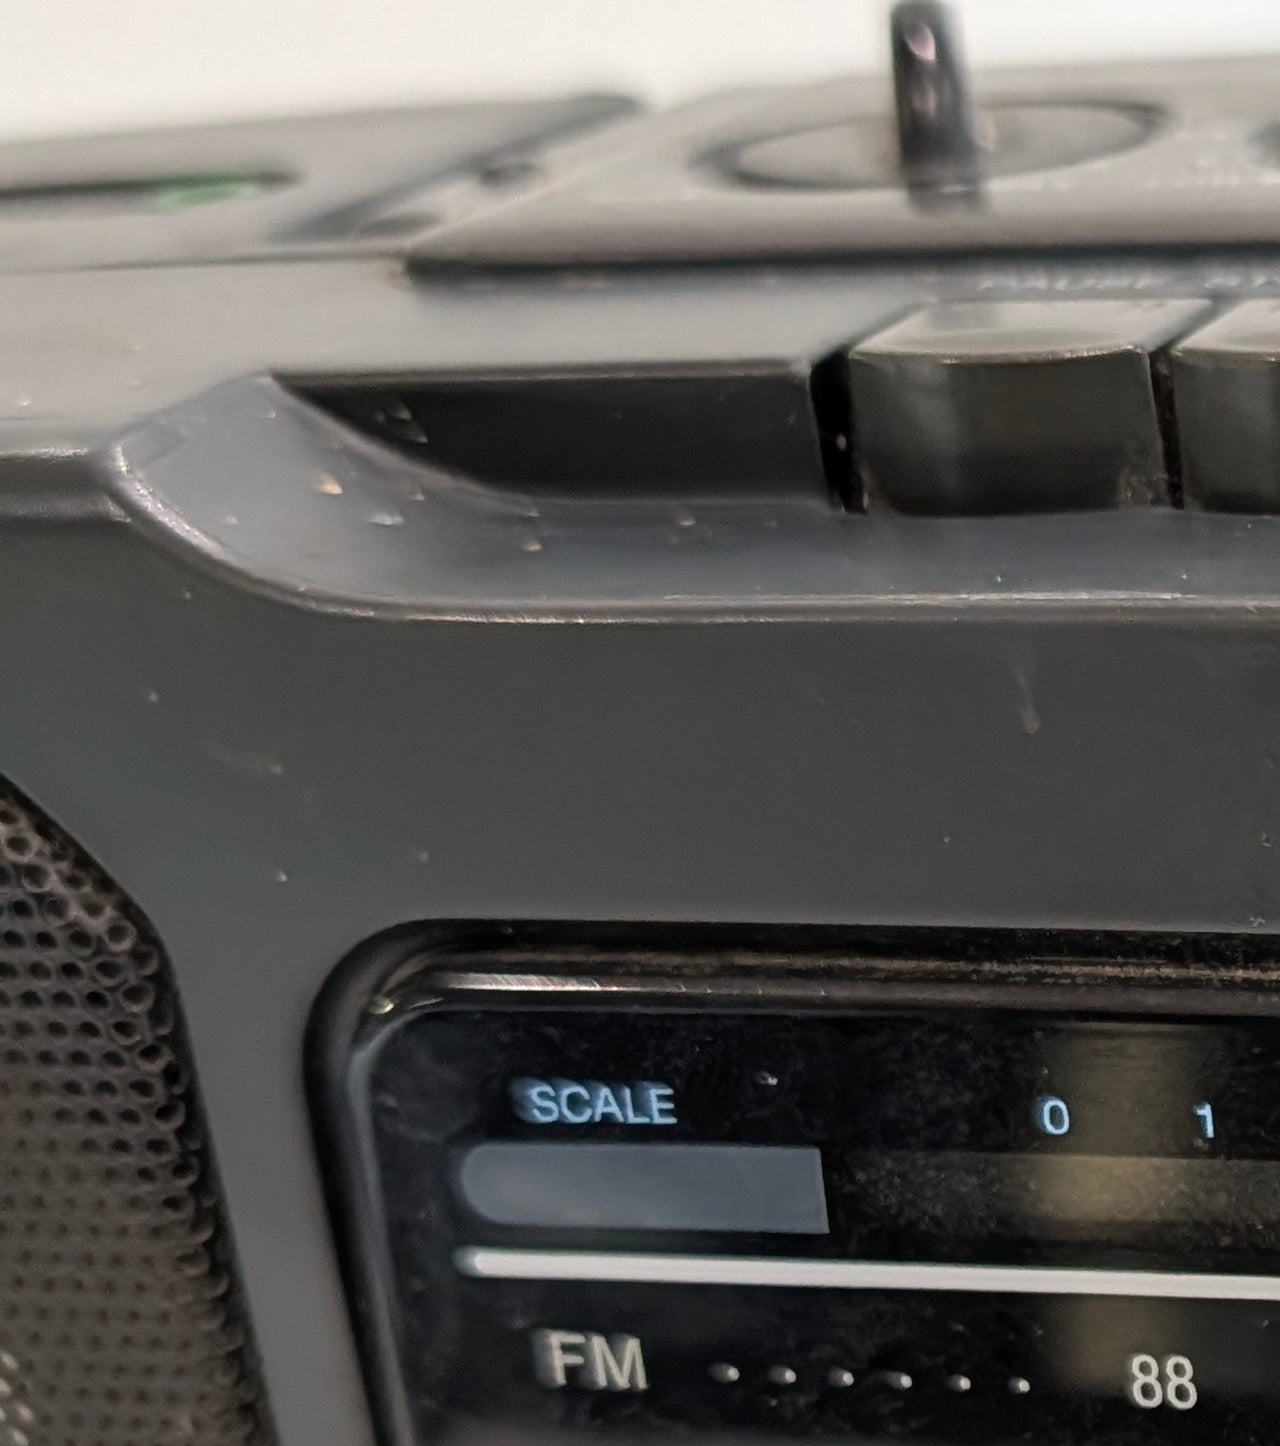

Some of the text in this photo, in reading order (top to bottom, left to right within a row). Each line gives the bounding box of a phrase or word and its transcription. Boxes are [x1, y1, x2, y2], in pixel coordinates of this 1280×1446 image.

[520, 1079, 680, 1127] SCALE
[1040, 1095, 1072, 1137] 0
[1194, 1101, 1217, 1140] 1
[539, 1328, 650, 1392] FM
[1126, 1351, 1200, 1412] 88
